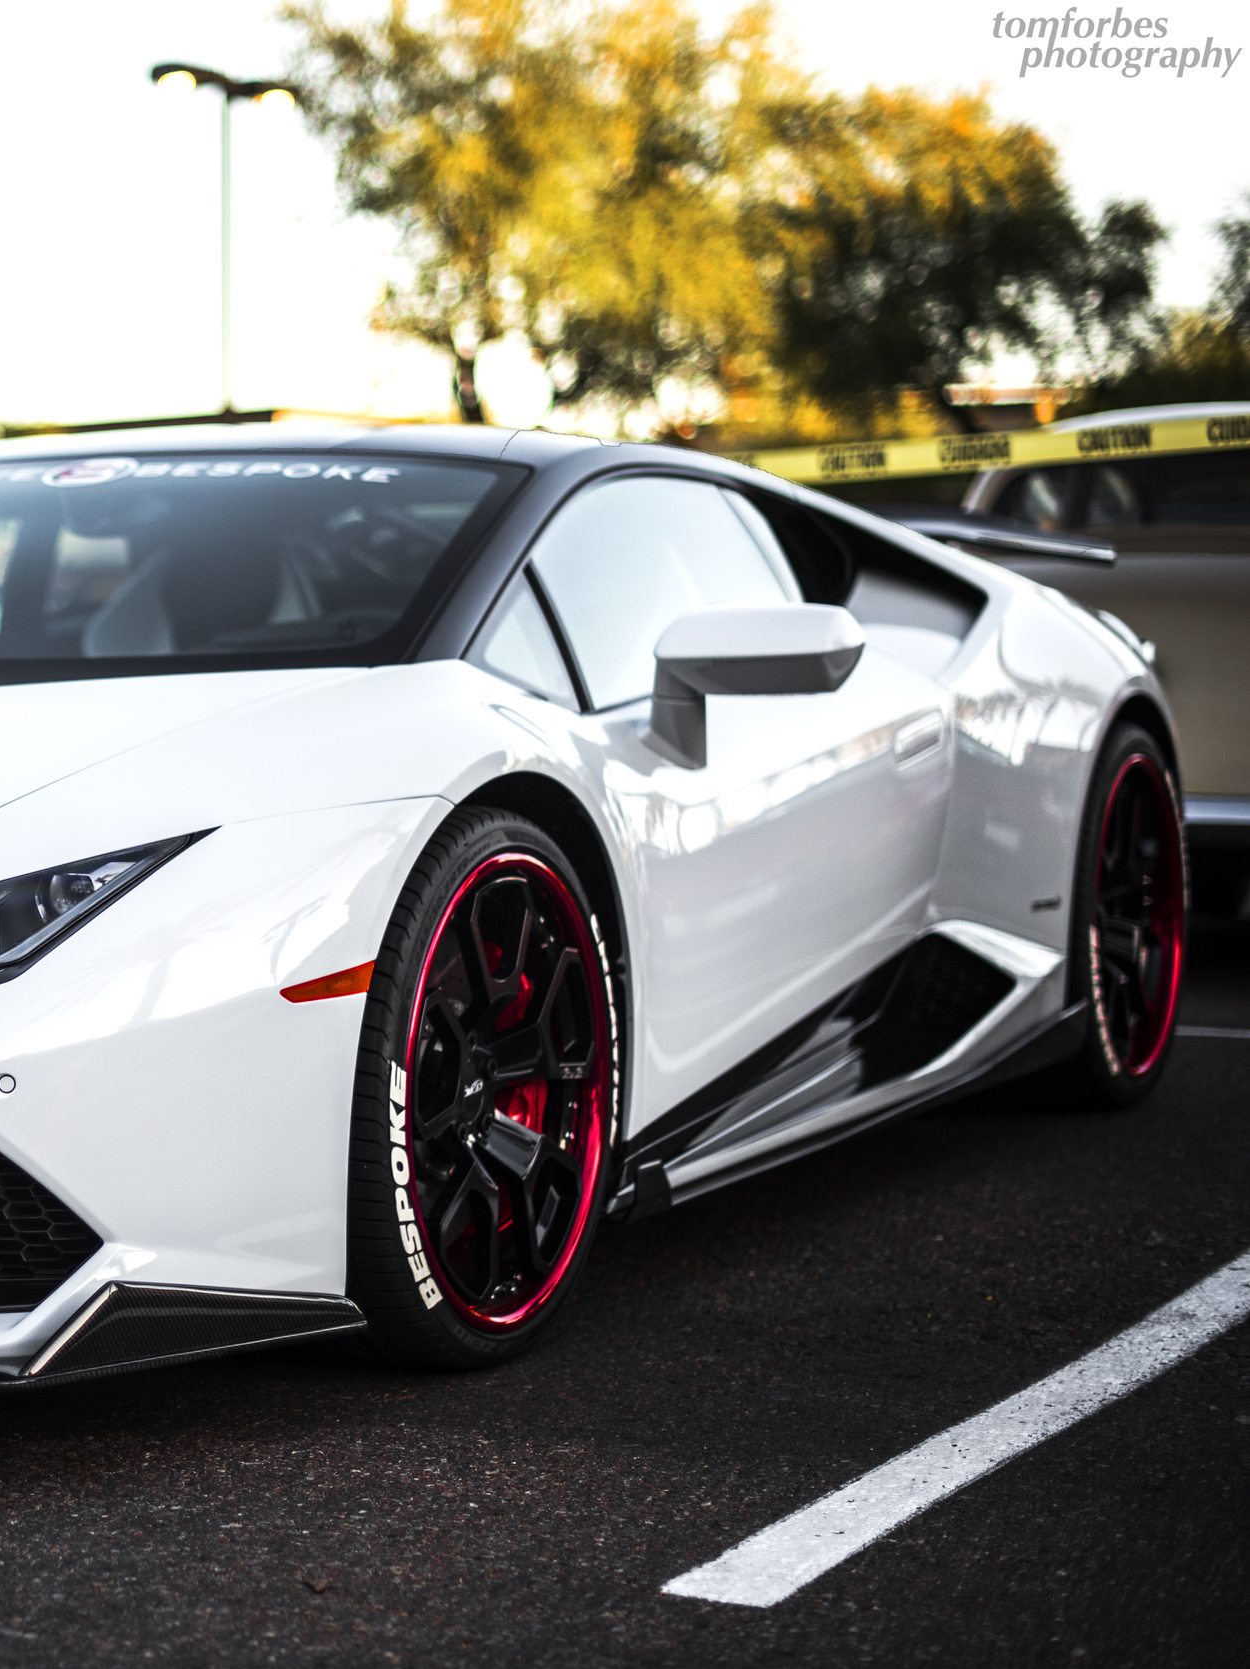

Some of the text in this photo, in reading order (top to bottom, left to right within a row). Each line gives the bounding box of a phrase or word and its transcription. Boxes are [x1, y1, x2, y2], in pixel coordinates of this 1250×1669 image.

[1077, 424, 1152, 453] CAUTION
[133, 461, 400, 484] BESPOKE
[389, 1060, 443, 1310] BESPOKE
